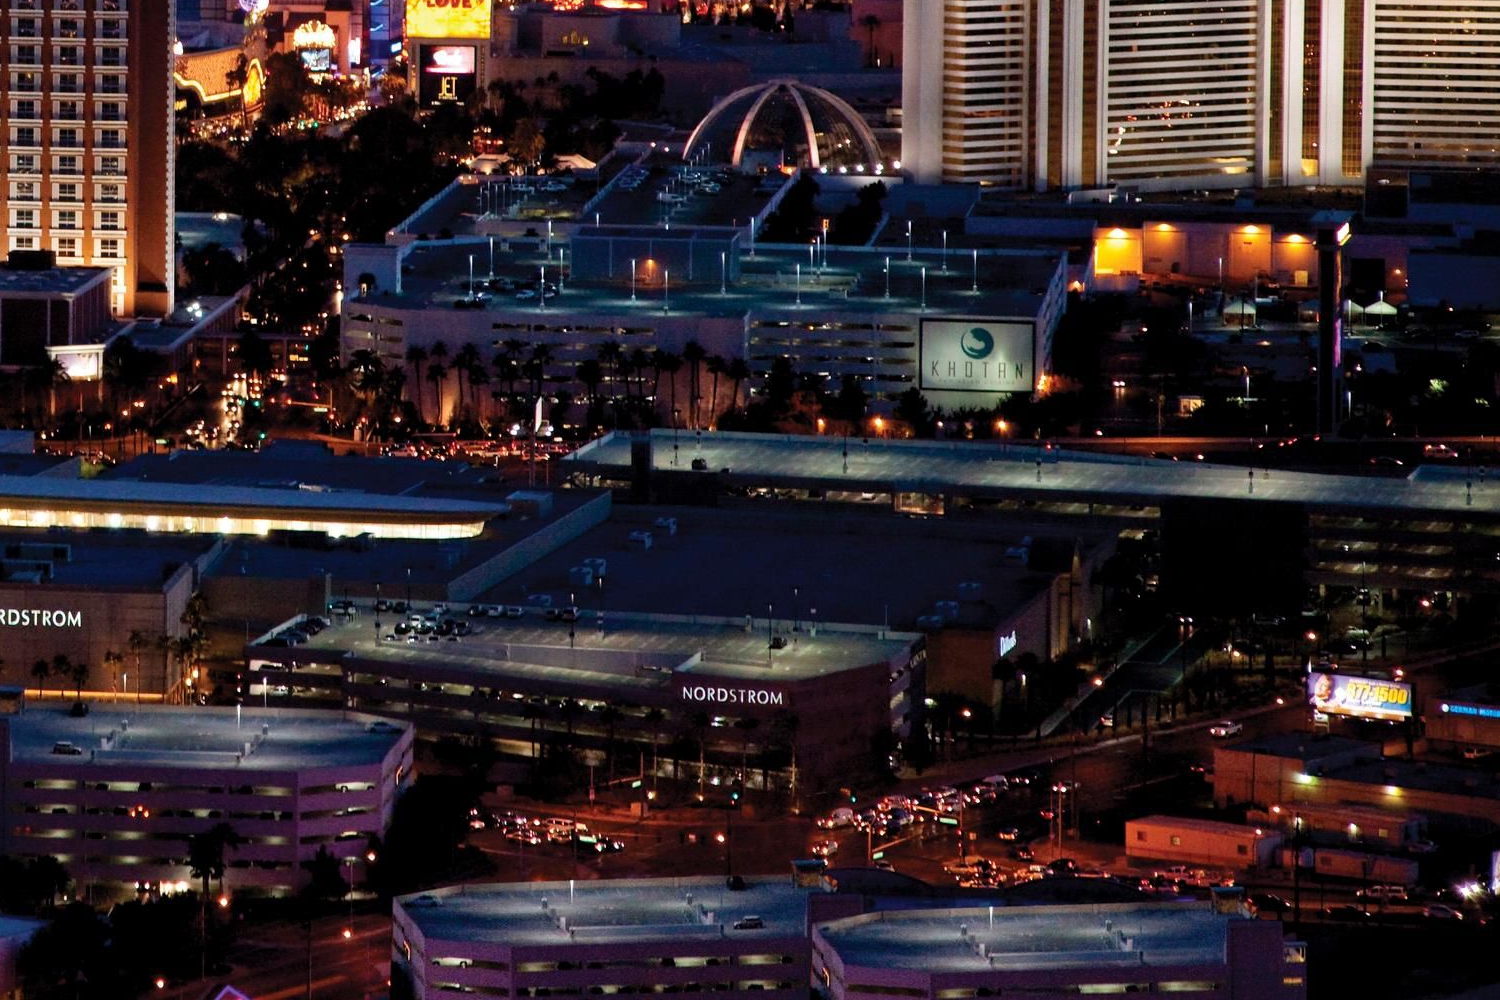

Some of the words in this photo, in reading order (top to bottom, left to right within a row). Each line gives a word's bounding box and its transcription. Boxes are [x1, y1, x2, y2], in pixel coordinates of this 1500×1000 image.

[438, 76, 458, 97] JET
[931, 361, 1023, 379] KHOTAN
[683, 686, 783, 705] NORDSTROM
